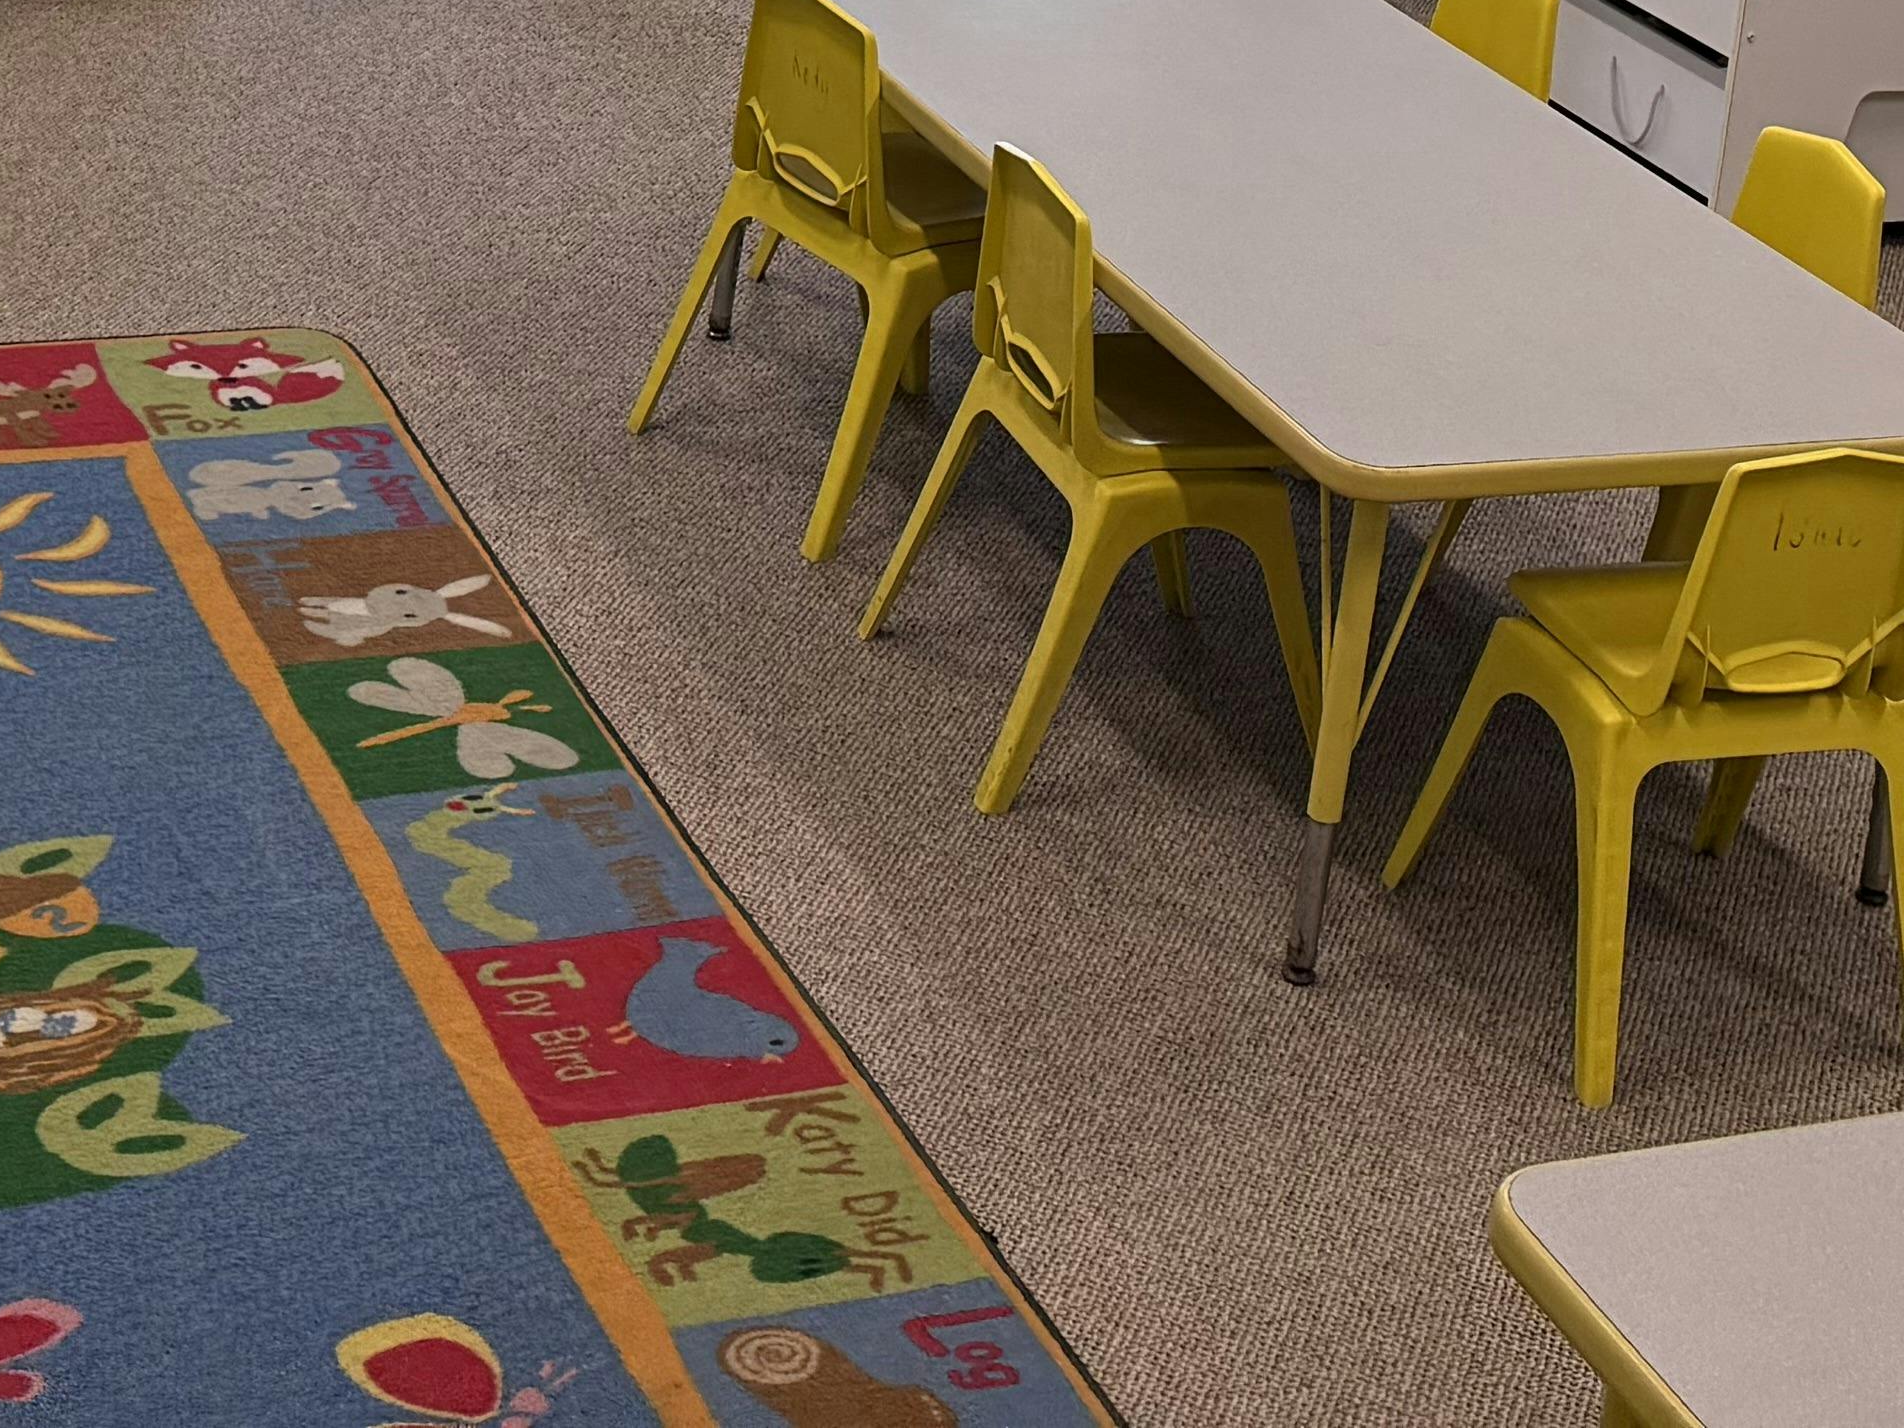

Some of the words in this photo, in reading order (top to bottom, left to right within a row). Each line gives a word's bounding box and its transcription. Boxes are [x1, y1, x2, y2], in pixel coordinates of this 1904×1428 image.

[142, 403, 243, 435] Fox
[32, 905, 87, 932] 2
[476, 958, 586, 1020] Jay
[528, 1030, 620, 1085] Bird
[743, 1090, 871, 1181] Katy
[844, 1193, 931, 1253] Did
[903, 1305, 1022, 1391] Log
